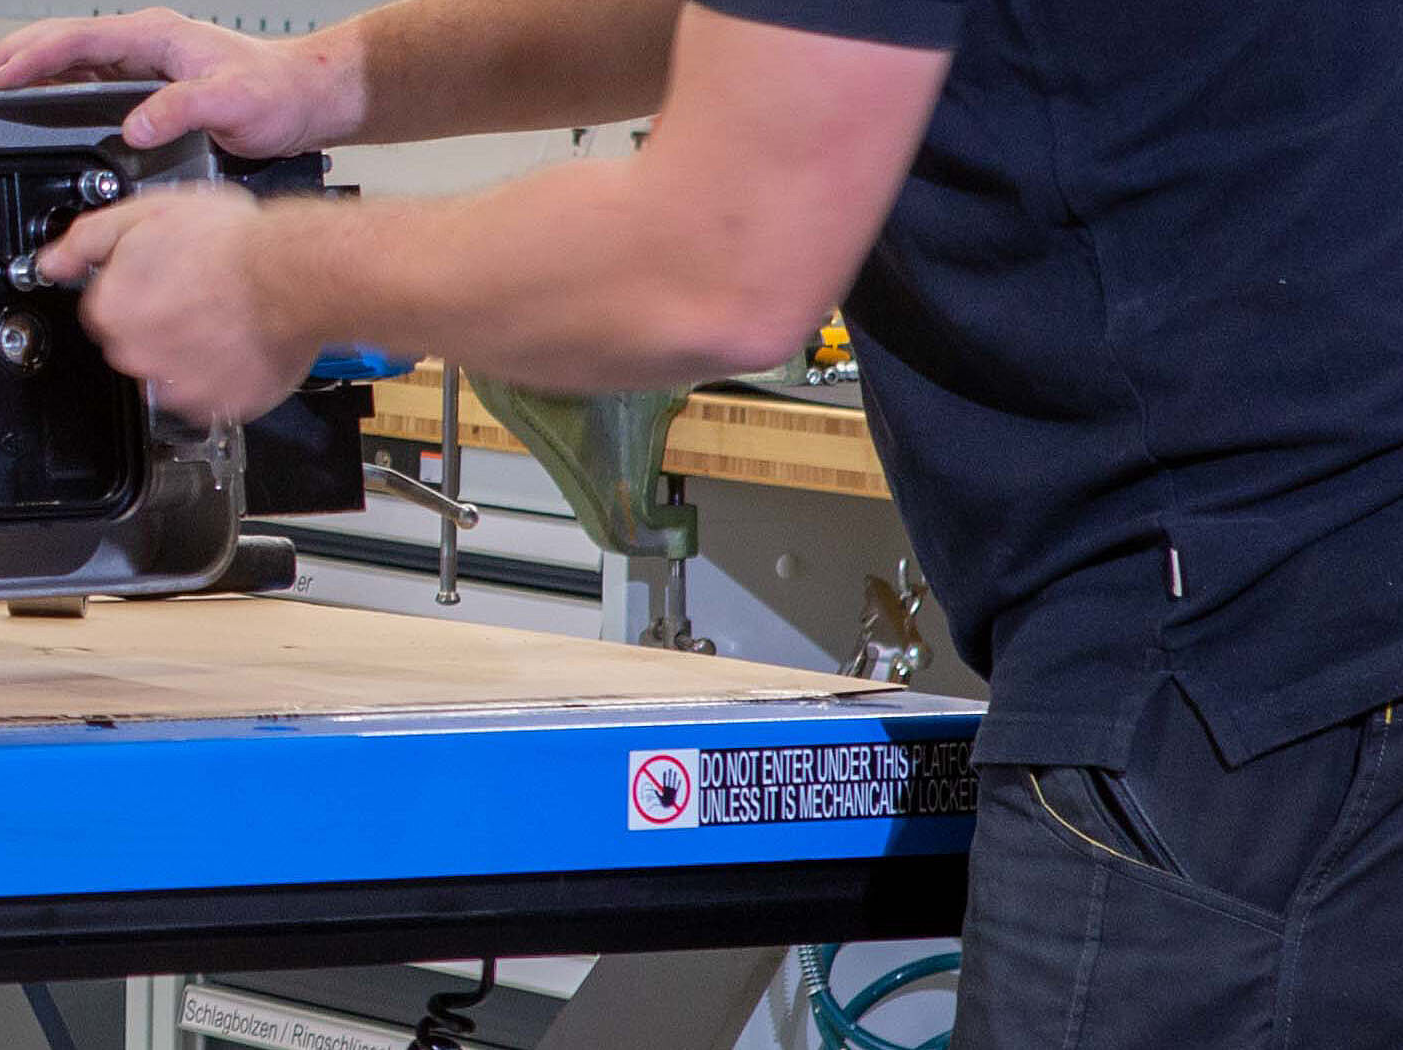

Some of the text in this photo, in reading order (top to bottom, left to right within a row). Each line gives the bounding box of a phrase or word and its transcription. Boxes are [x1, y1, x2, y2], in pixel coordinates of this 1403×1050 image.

[700, 752, 724, 787] DO
[726, 751, 759, 786] NOT
[762, 748, 814, 784] ENTER
[817, 745, 871, 782] UNDER
[873, 744, 909, 780] THIS
[700, 788, 760, 823] UNLESS
[764, 785, 779, 820] IT
[781, 785, 797, 820] IS
[799, 779, 916, 819] MECHANICALLY
[185, 999, 278, 1040] Schlagbolzen
